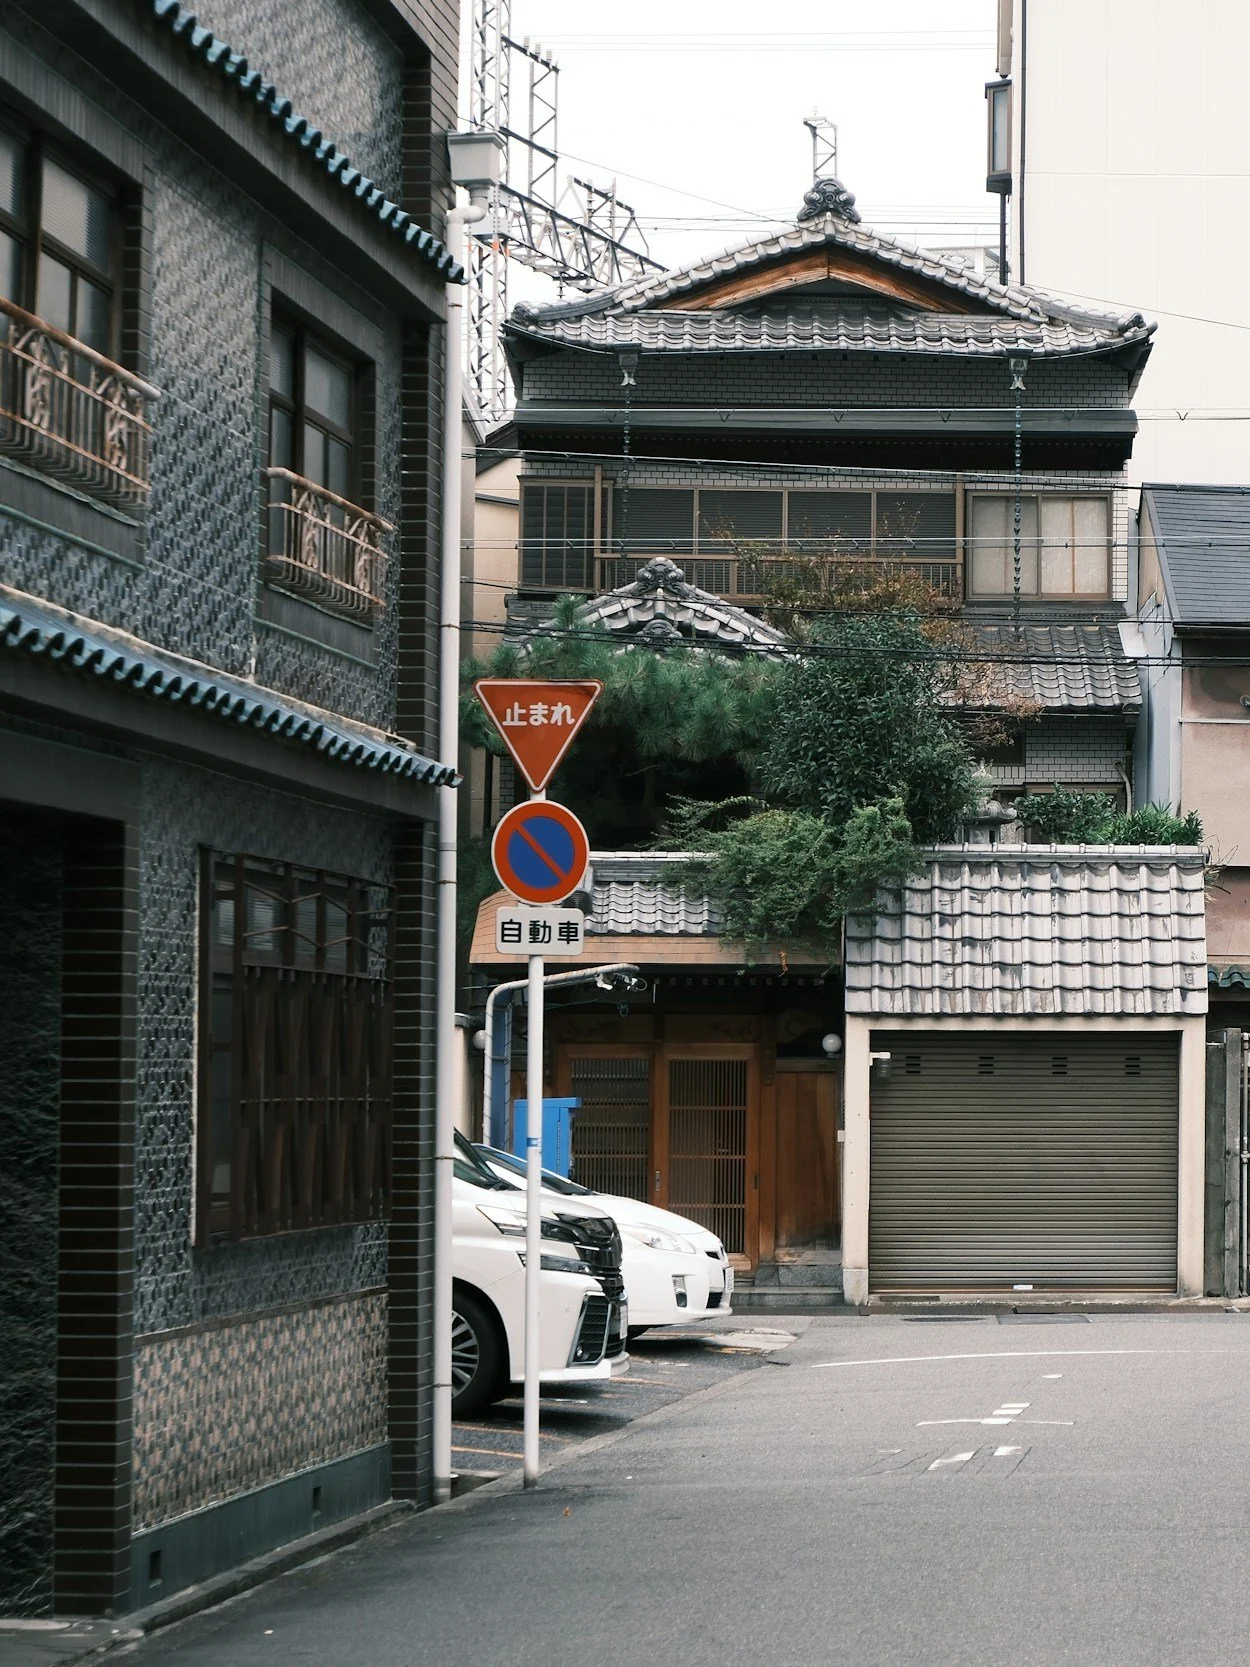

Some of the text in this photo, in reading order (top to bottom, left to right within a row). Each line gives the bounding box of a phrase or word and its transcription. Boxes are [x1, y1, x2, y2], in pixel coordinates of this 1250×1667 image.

[501, 701, 575, 727] 止まれ
[500, 918, 580, 945] 自動車
